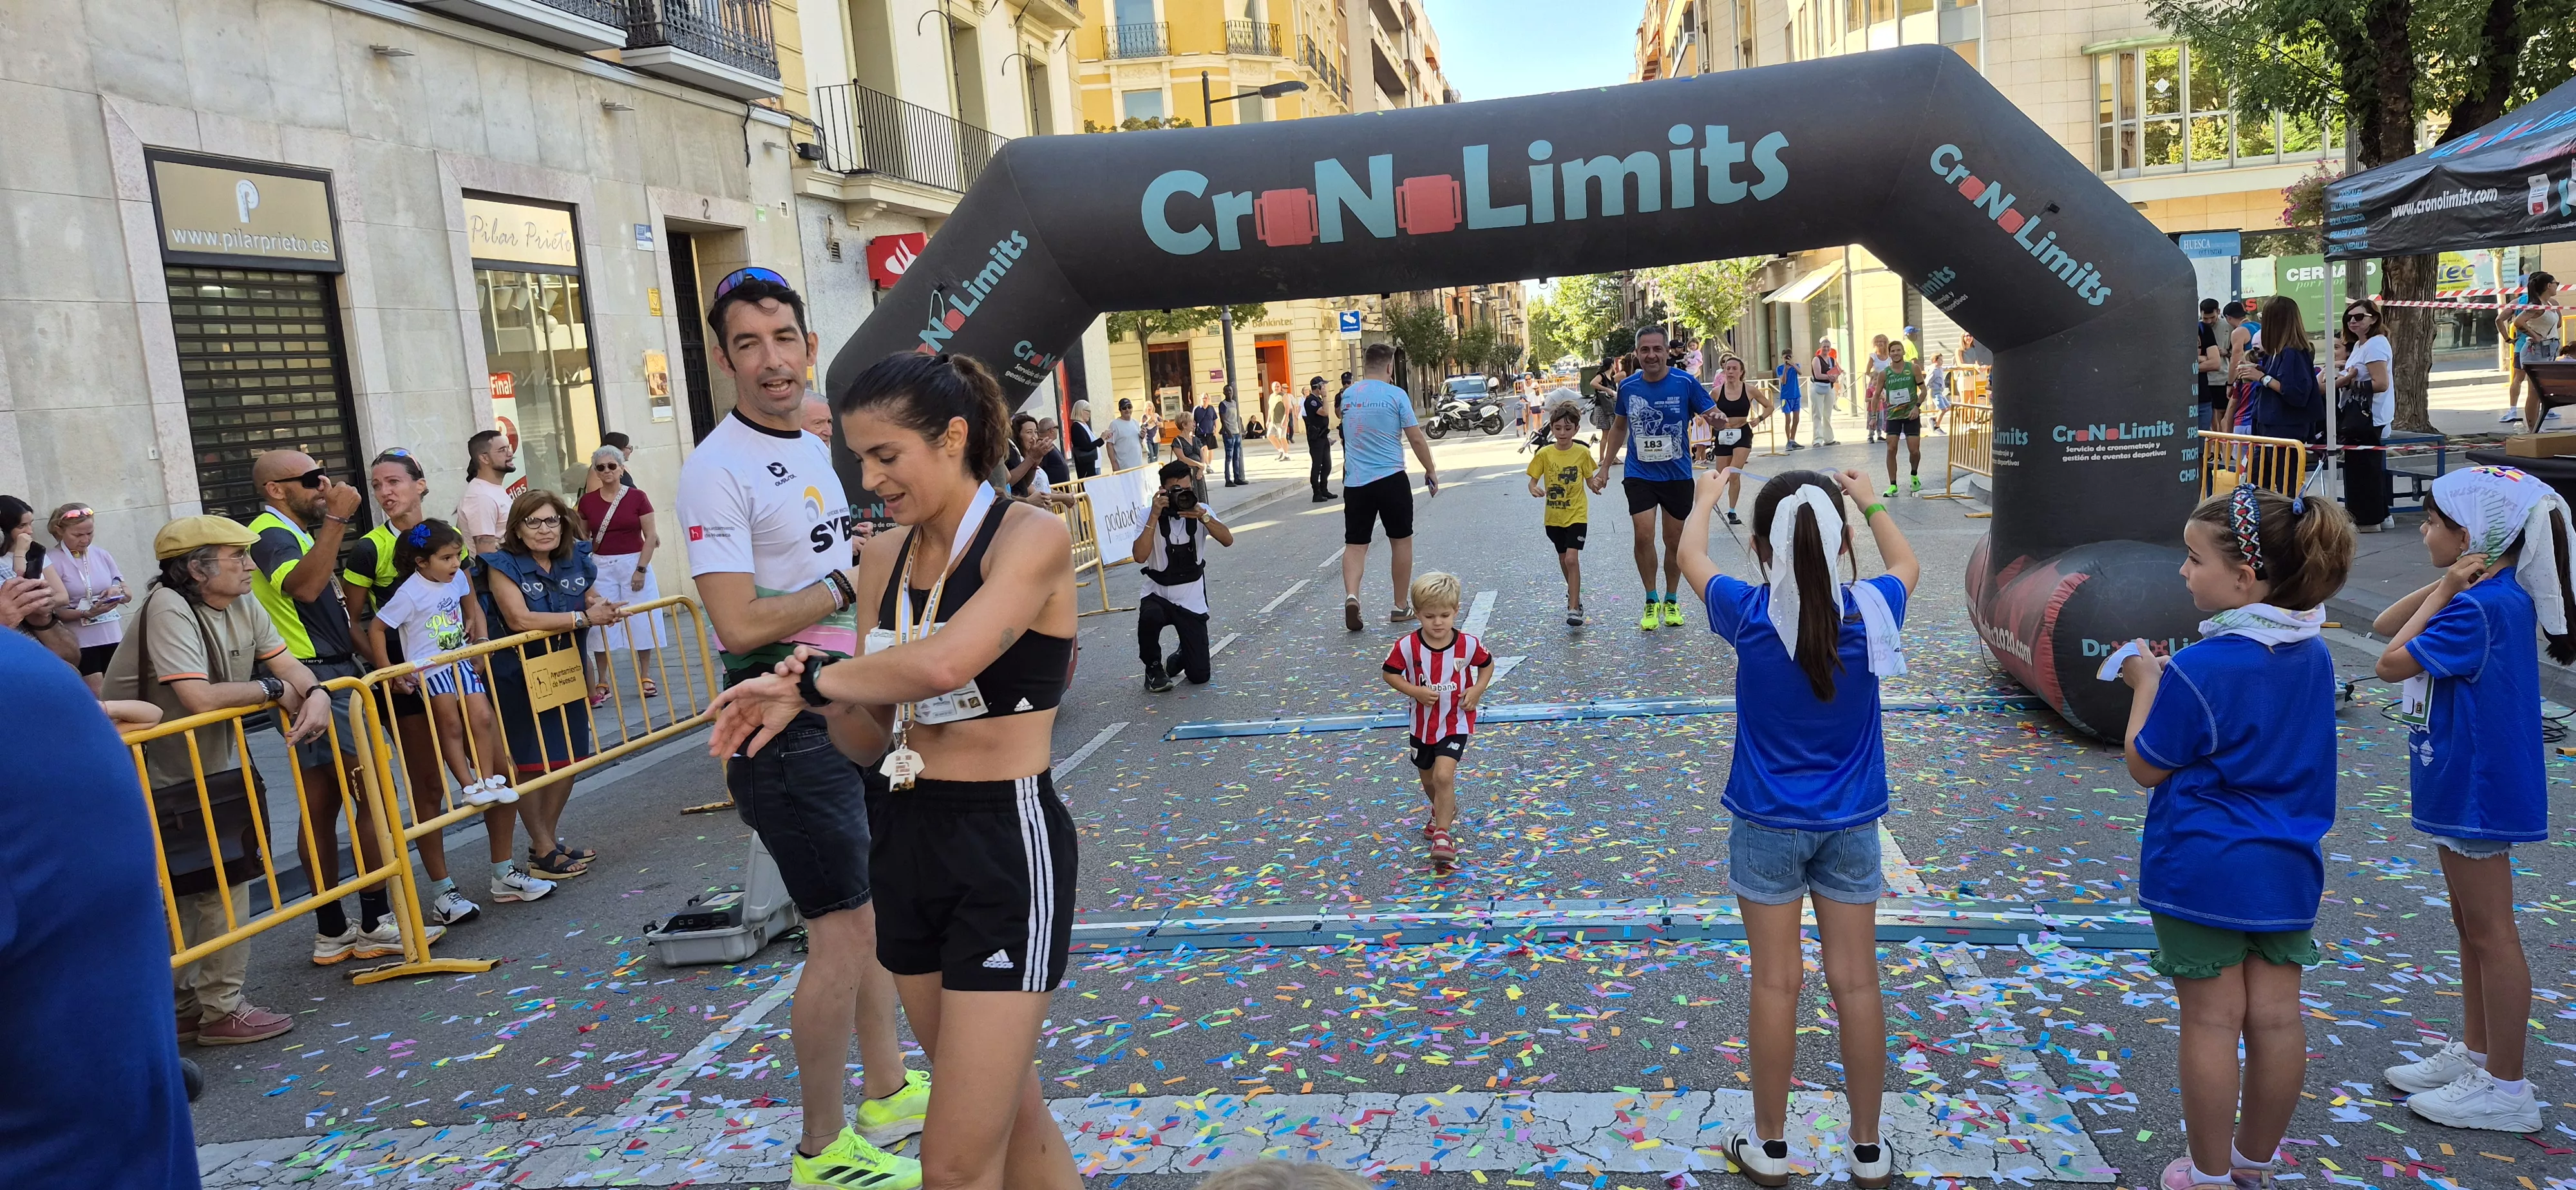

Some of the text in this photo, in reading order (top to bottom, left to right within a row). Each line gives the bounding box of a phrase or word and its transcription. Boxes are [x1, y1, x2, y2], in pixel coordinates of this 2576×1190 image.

[702, 198, 711, 220] 2
[2391, 187, 2498, 218] www.cronolimits.com
[171, 228, 330, 254] www.pilarprieto.es
[470, 214, 573, 253] Pilar Prieto
[2183, 238, 2211, 250] HUESCA
[489, 374, 513, 395] Final
[1643, 440, 1663, 449] 183
[2065, 445, 2095, 453] Servicio
[2107, 442, 2155, 451] cronometraje
[2062, 454, 2090, 462] gestión
[2132, 449, 2167, 459] deportivos
[508, 483, 527, 501] días
